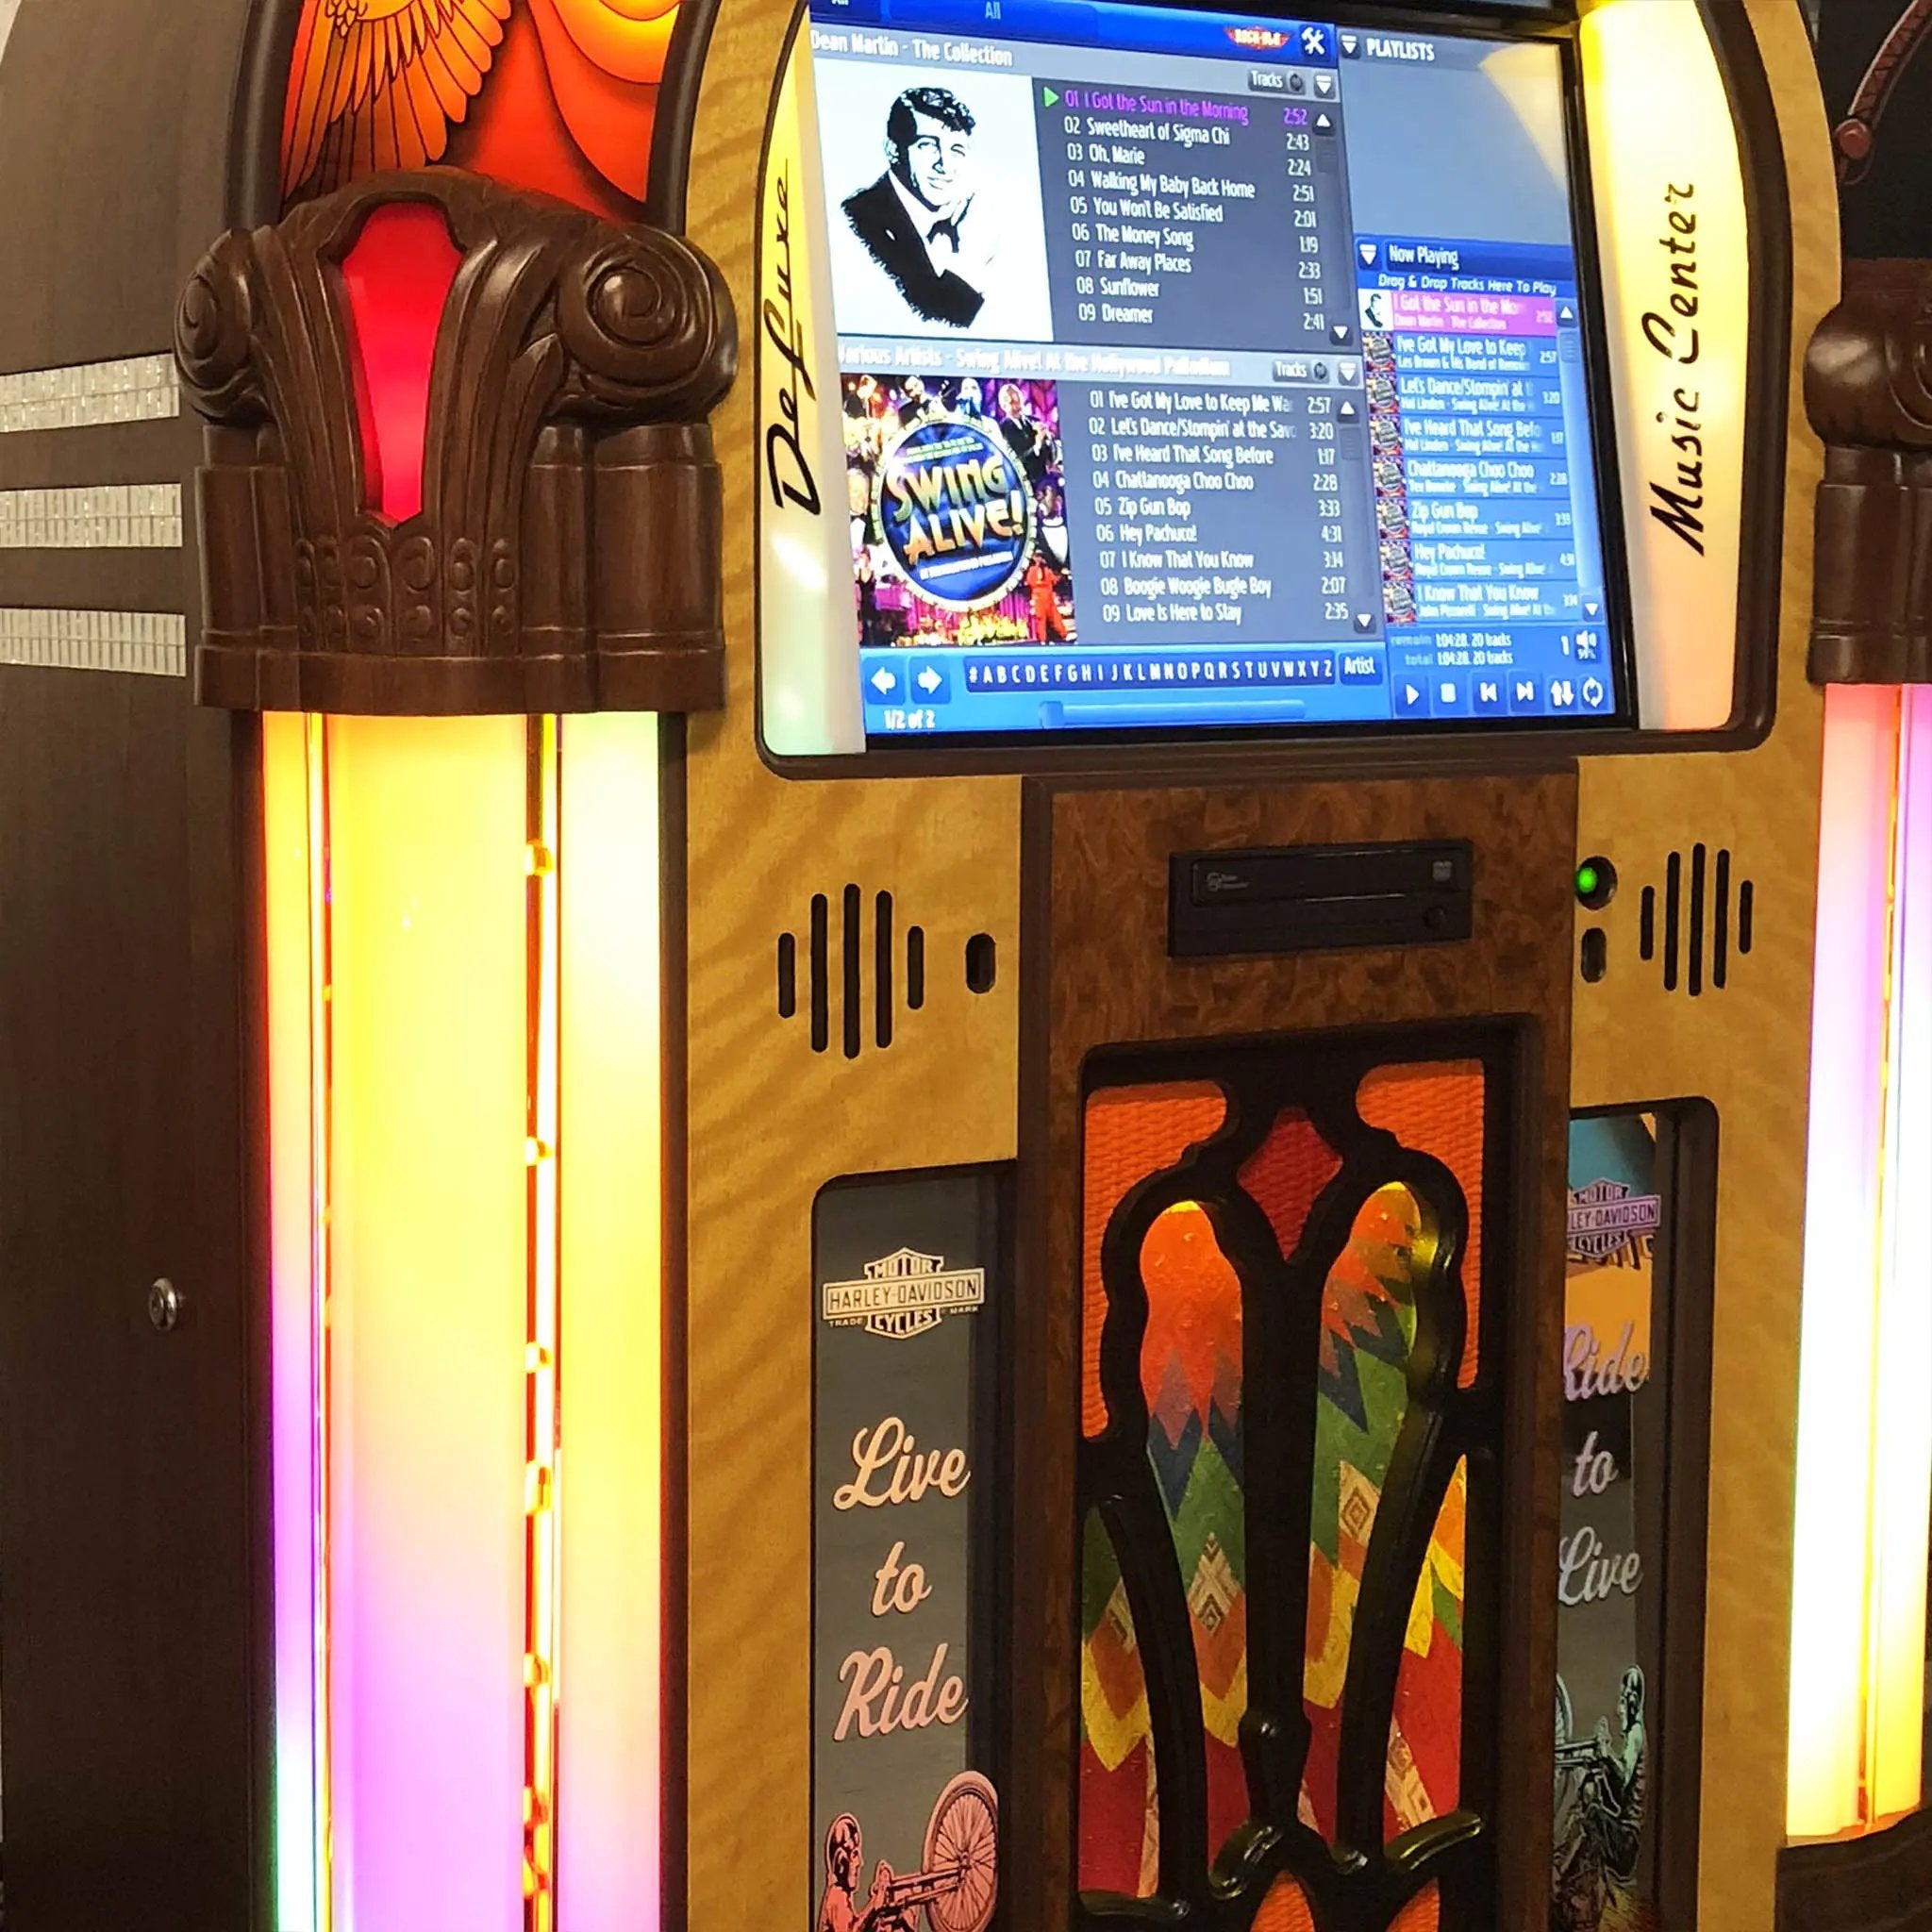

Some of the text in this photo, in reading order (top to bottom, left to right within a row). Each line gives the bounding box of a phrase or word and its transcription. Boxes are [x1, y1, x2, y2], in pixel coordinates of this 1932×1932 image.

[985, 2, 1001, 20] All
[809, 30, 1013, 67] Dean Martin The Collection
[1366, 38, 1435, 61] PLAYLISTS
[1251, 69, 1283, 89] Tracks
[1064, 90, 1079, 108] 01
[1093, 92, 1114, 111] Got
[1116, 94, 1136, 112] the
[1140, 95, 1162, 115] Sun
[1165, 97, 1177, 116] in
[1179, 98, 1199, 117] the
[1201, 100, 1250, 126] Morning
[1064, 115, 1309, 151] 02 Sweetheart of Sigma Chi 2:43
[1067, 142, 1083, 161] 03
[1112, 145, 1145, 165] Marie
[1288, 158, 1311, 176] 2:24
[1068, 168, 1314, 202] 04 Walking My Baby Back Home 2:51
[1070, 196, 1087, 214] 05
[1092, 196, 1118, 217] You
[1154, 200, 1171, 220] Be
[1174, 202, 1224, 223] Satisfied
[1293, 209, 1316, 228] 2:01
[1072, 223, 1090, 242] 06
[1095, 224, 1119, 243] The
[1122, 225, 1161, 249] Money
[1163, 227, 1194, 252] Song
[1075, 250, 1321, 280] 07 Far Away Places 2:33
[1389, 244, 1460, 271] Now Playing
[1076, 275, 1094, 294] 08
[1100, 277, 1160, 297] Sunflower
[1378, 273, 1406, 290] Drag
[1421, 275, 1448, 292] Drop
[1452, 277, 1485, 291] Tracks
[1488, 278, 1513, 292] Here
[1516, 280, 1529, 293] To
[1532, 281, 1557, 298] Play
[1079, 303, 1324, 331] 09 Dreamer 2:41
[1274, 359, 1307, 377] Tracks
[1641, 183, 1705, 557] Music Center
[1090, 390, 1105, 409] 01
[1131, 391, 1152, 411] Got
[1154, 392, 1172, 415] My
[1174, 393, 1204, 412] Love
[1206, 394, 1218, 412] to
[1220, 394, 1250, 417] Keep
[1252, 395, 1271, 413] Me
[1089, 417, 1106, 436] 02
[1232, 421, 1246, 439] at
[1247, 421, 1268, 440] the
[1309, 423, 1333, 441] 3:20
[1091, 443, 1108, 463] 03
[1135, 444, 1171, 464] Heard
[1173, 445, 1201, 464] That
[1203, 445, 1234, 470] Song
[1236, 446, 1274, 465] Before
[1092, 470, 1338, 495] 04 Chattanooga Choo Choo 2:28
[1094, 496, 1112, 516] 05
[1118, 496, 1138, 520] Zip
[1140, 497, 1165, 516] Gun
[1167, 497, 1191, 521] Bop
[1096, 524, 1114, 542] 06
[1119, 524, 1143, 547] Hey
[1099, 550, 1116, 569] 07
[1122, 550, 1127, 569] I
[1129, 550, 1163, 569] Know
[1165, 550, 1193, 569] That
[1194, 550, 1219, 569] You
[1221, 550, 1255, 569] Know
[1100, 576, 1346, 600] 08 Boogie Woogie Bugle Boy 2:07
[1103, 604, 1121, 623] 09
[1125, 604, 1156, 623] Love
[1157, 604, 1168, 622] Is
[1170, 604, 1199, 622] Here
[1200, 604, 1213, 622] to
[1215, 604, 1242, 625] Stay
[1344, 656, 1375, 675] Artist
[926, 709, 937, 728] 2
[1577, 1185, 1624, 1205] MOTOR
[1577, 1231, 1623, 1254] CYCLES
[872, 1256, 935, 1279] MOTOR
[829, 1278, 977, 1309] HARLEY-DAVIDSON
[829, 1306, 979, 1328] TRADE MARK
[874, 1308, 933, 1334] CYCLES
[1563, 1321, 1651, 1402] Ride
[833, 1416, 972, 1510] Live
[1573, 1430, 1619, 1498] to
[872, 1541, 933, 1617] to
[1557, 1525, 1643, 1607] Live
[833, 1642, 970, 1742] Ride
